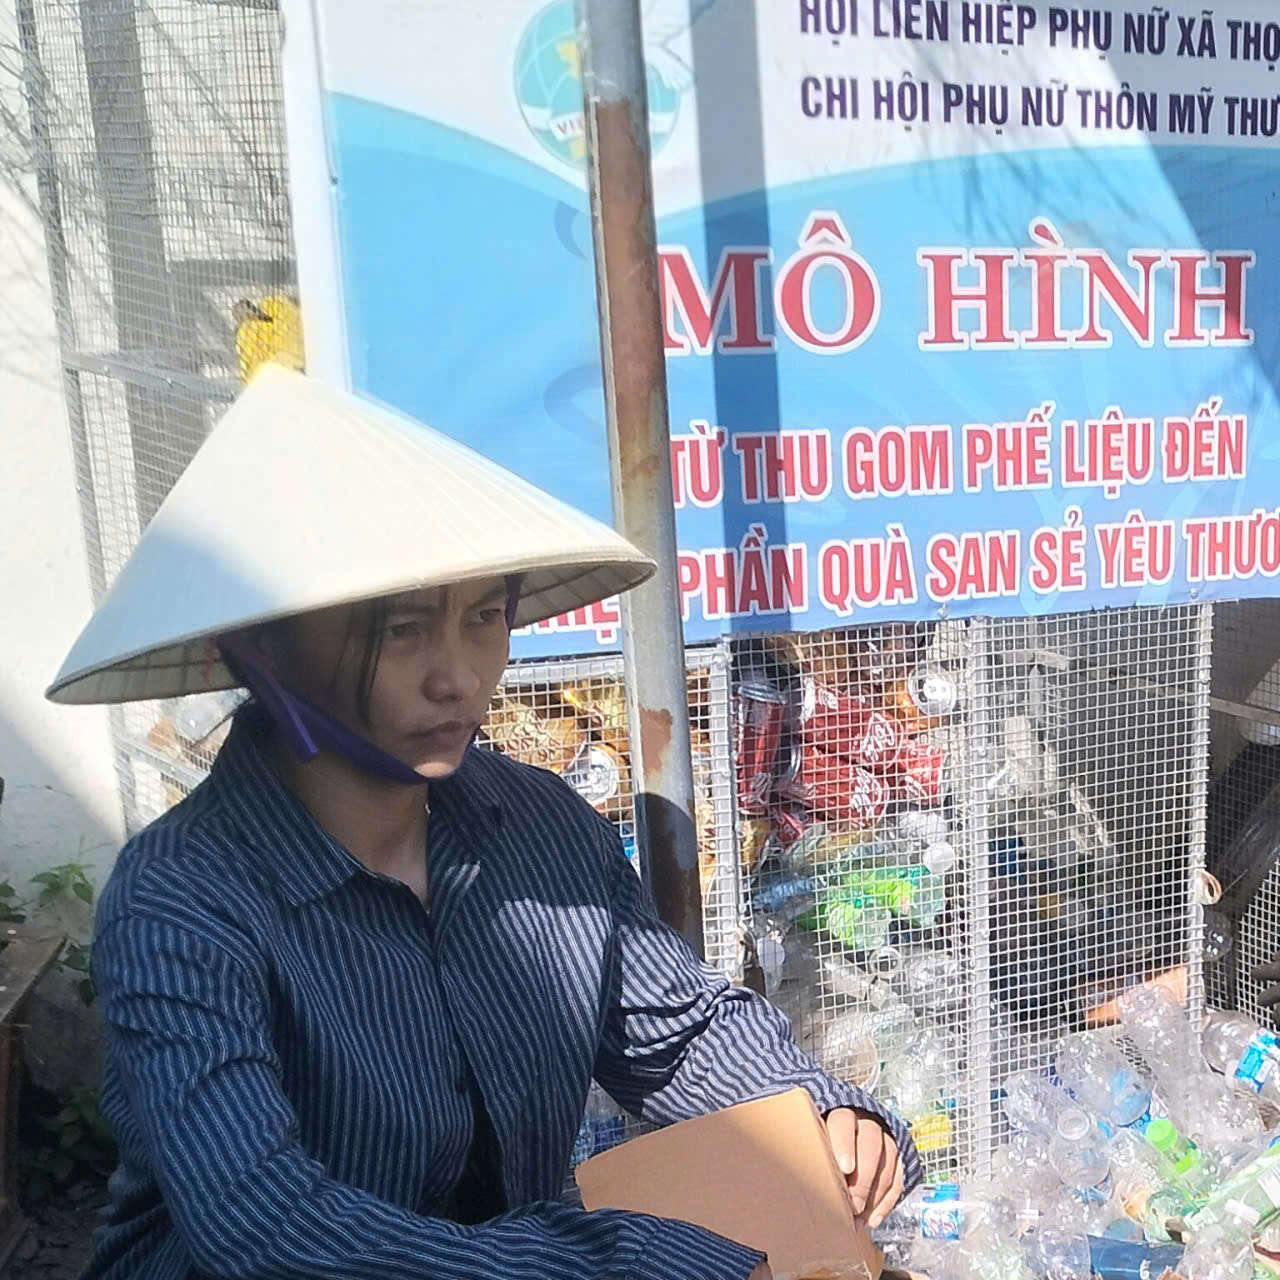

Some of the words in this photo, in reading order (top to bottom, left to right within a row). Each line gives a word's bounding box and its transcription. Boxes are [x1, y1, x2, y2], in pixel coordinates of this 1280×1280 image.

[1049, 8, 1112, 59] PHỤ
[1123, 7, 1169, 55] NỮ
[1176, 10, 1216, 58] XÃ
[1227, 20, 1280, 71] THỌ
[801, 76, 858, 120] CHI
[873, 71, 930, 132] HỘI
[943, 82, 1008, 135] PHỤ
[1021, 78, 1067, 127] NỮ
[1076, 82, 1158, 132] THÔN
[1169, 86, 1214, 135] MỸ
[658, 218, 876, 349] MÔ
[921, 222, 1252, 345] HÌNH
[670, 424, 725, 503] TỪ
[736, 433, 828, 500] THU
[846, 430, 950, 495] GOM
[967, 405, 1051, 489] PHẾ
[1066, 411, 1152, 495] LIỆU
[1164, 400, 1246, 480] ĐẾN
[677, 527, 804, 616] PHẦN
[822, 528, 914, 611] QUÀ
[929, 533, 1017, 597] SAN
[1032, 509, 1084, 590] SẺ
[1097, 517, 1171, 586] YÊU
